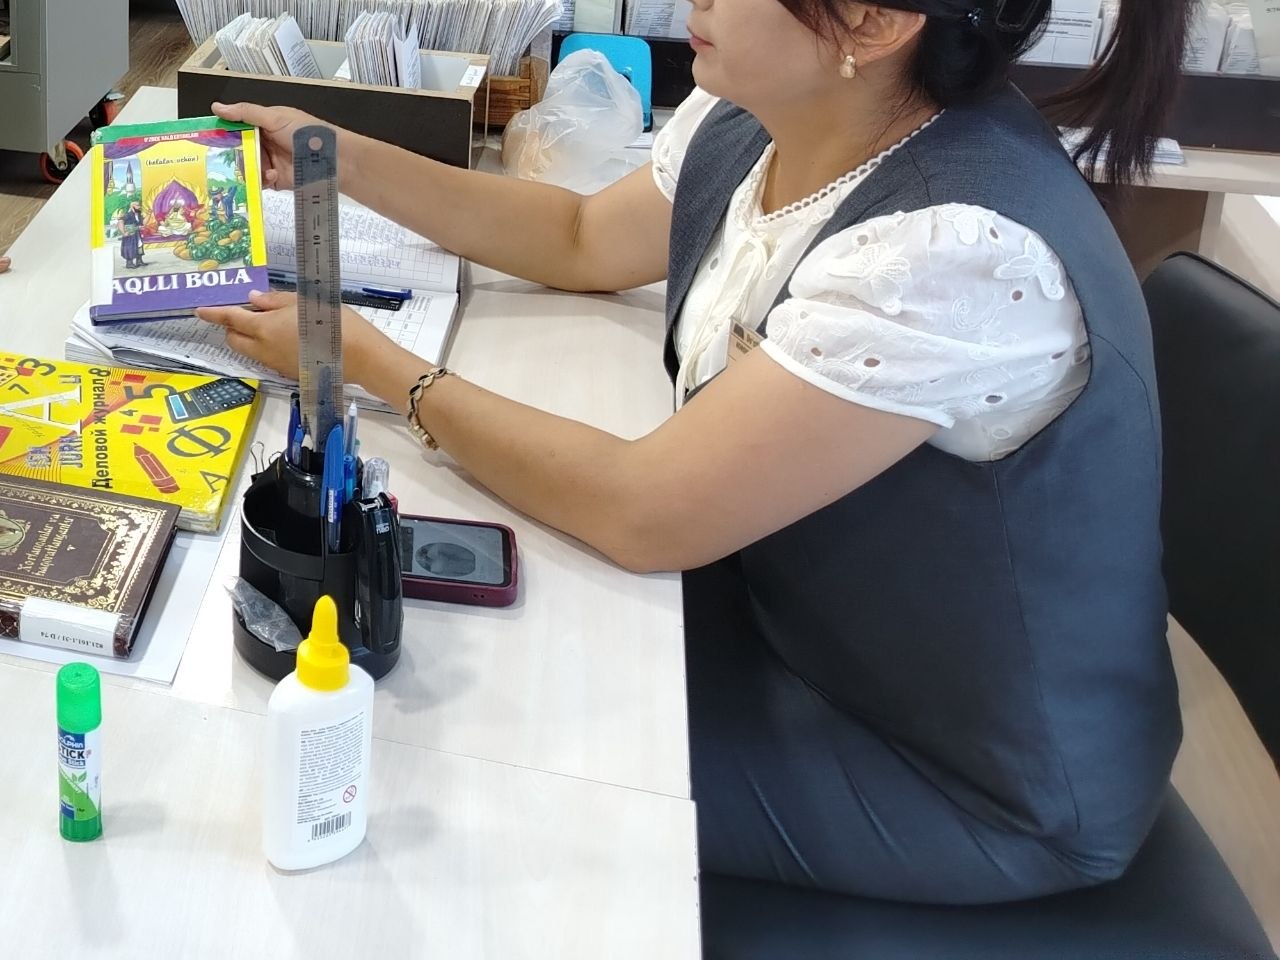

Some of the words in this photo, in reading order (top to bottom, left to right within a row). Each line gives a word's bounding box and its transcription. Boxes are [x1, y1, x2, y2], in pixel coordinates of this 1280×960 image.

[113, 273, 180, 296] AQLLI
[185, 268, 253, 290] BOLA
[91, 378, 108, 425] журнал
[91, 430, 113, 489] Деловой
